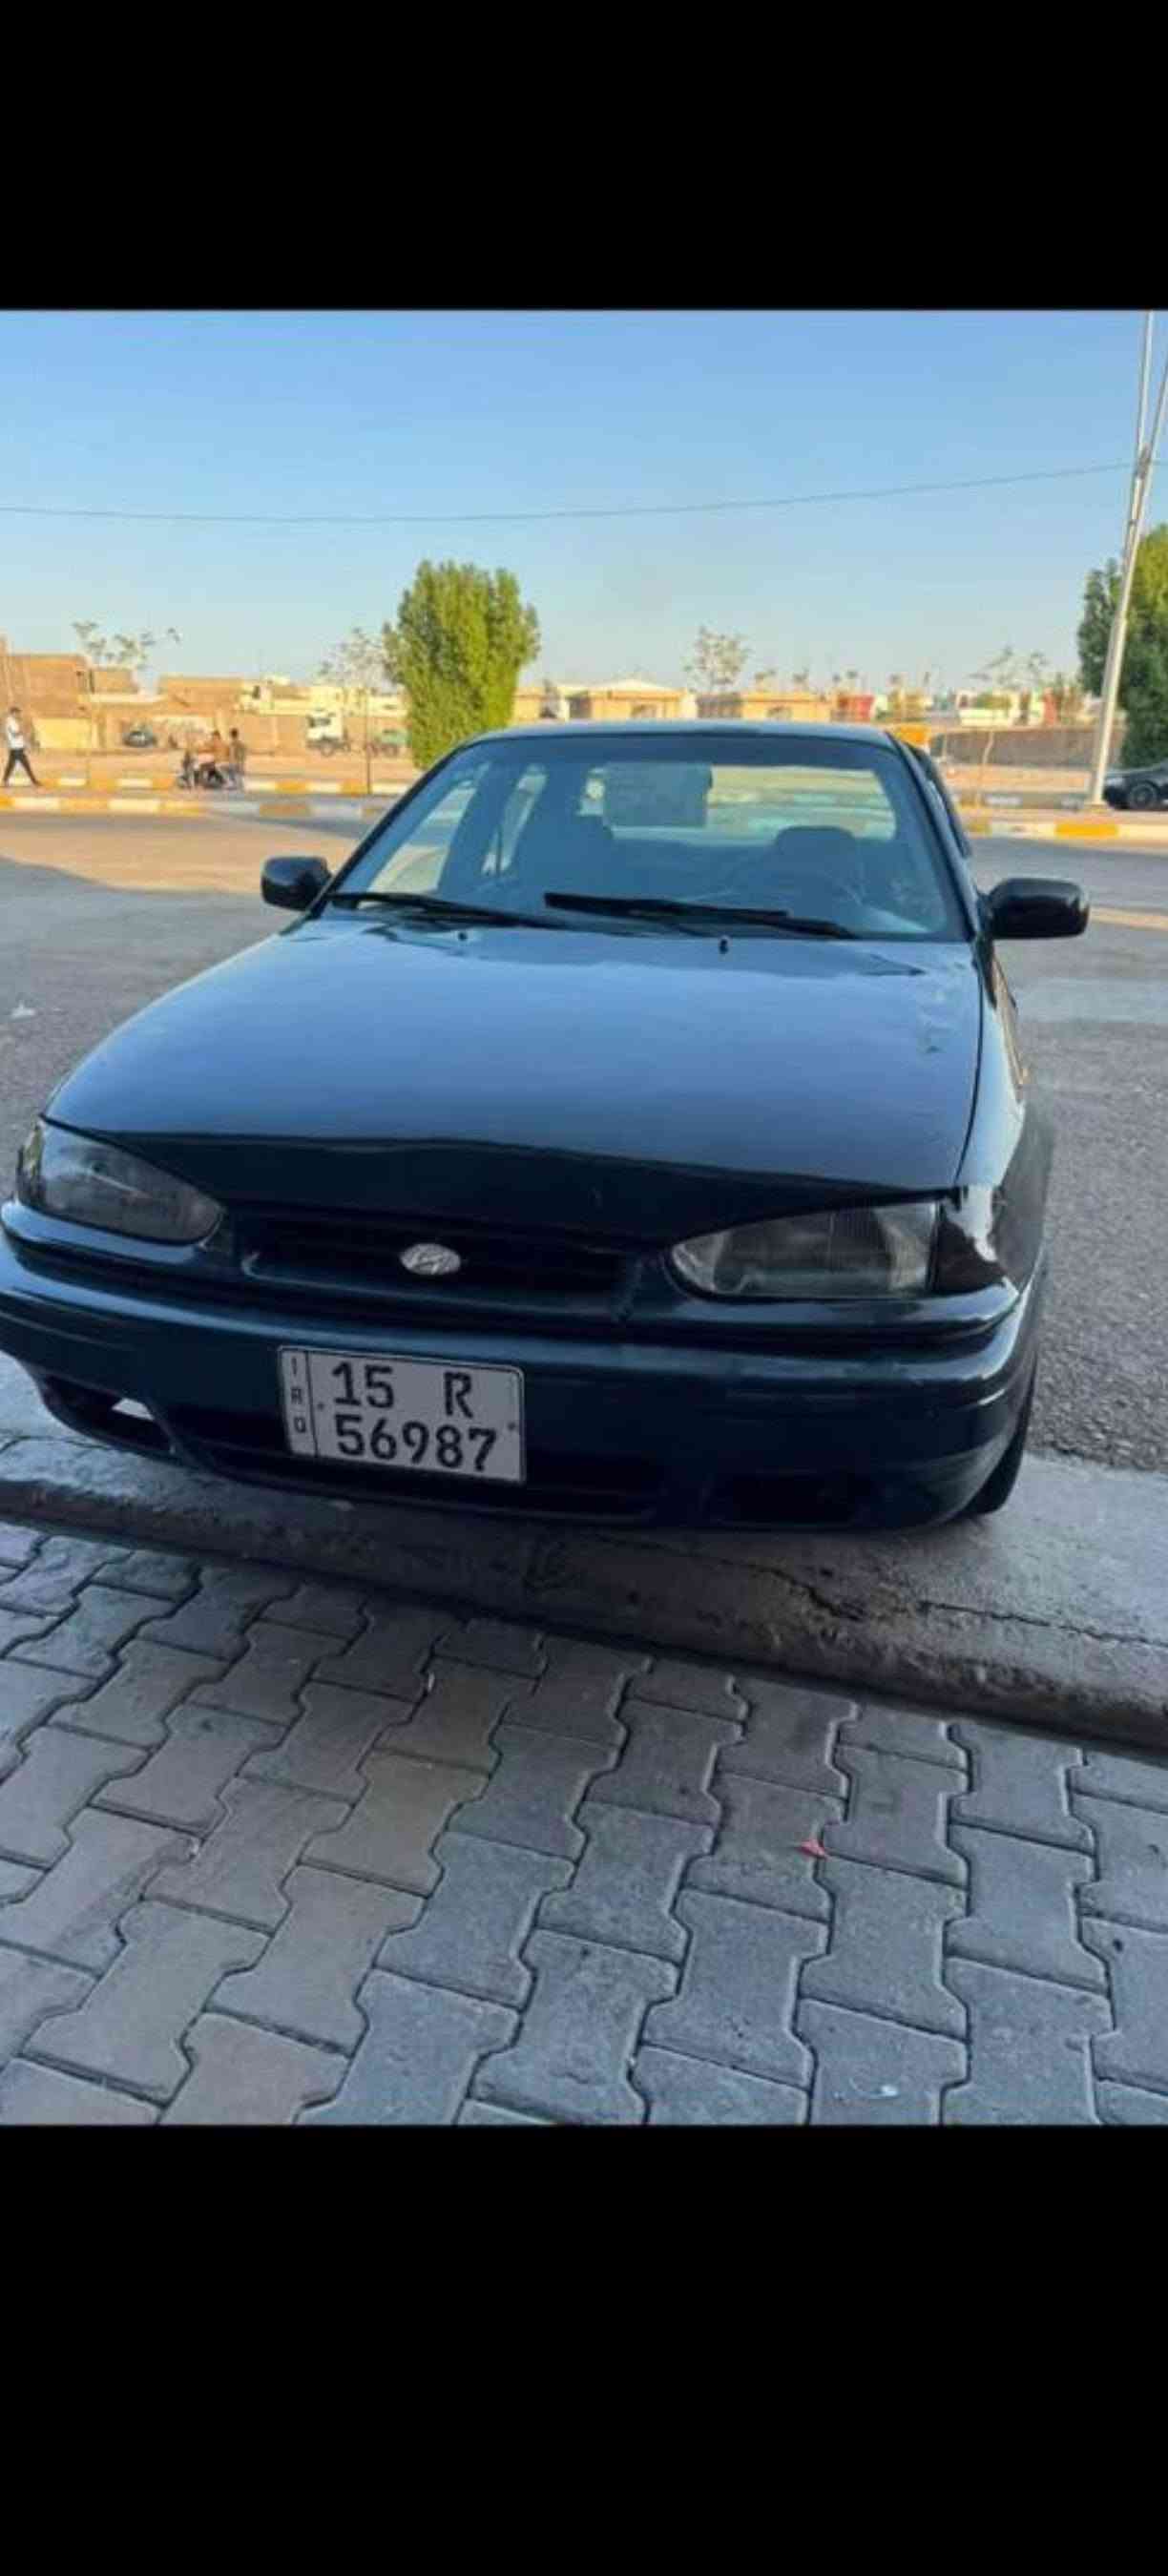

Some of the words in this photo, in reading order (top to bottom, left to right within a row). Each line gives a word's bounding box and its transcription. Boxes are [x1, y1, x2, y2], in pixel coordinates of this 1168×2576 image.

[331, 1361, 394, 1409] 15
[444, 1371, 474, 1419] R
[334, 1413, 498, 1472] 56987
